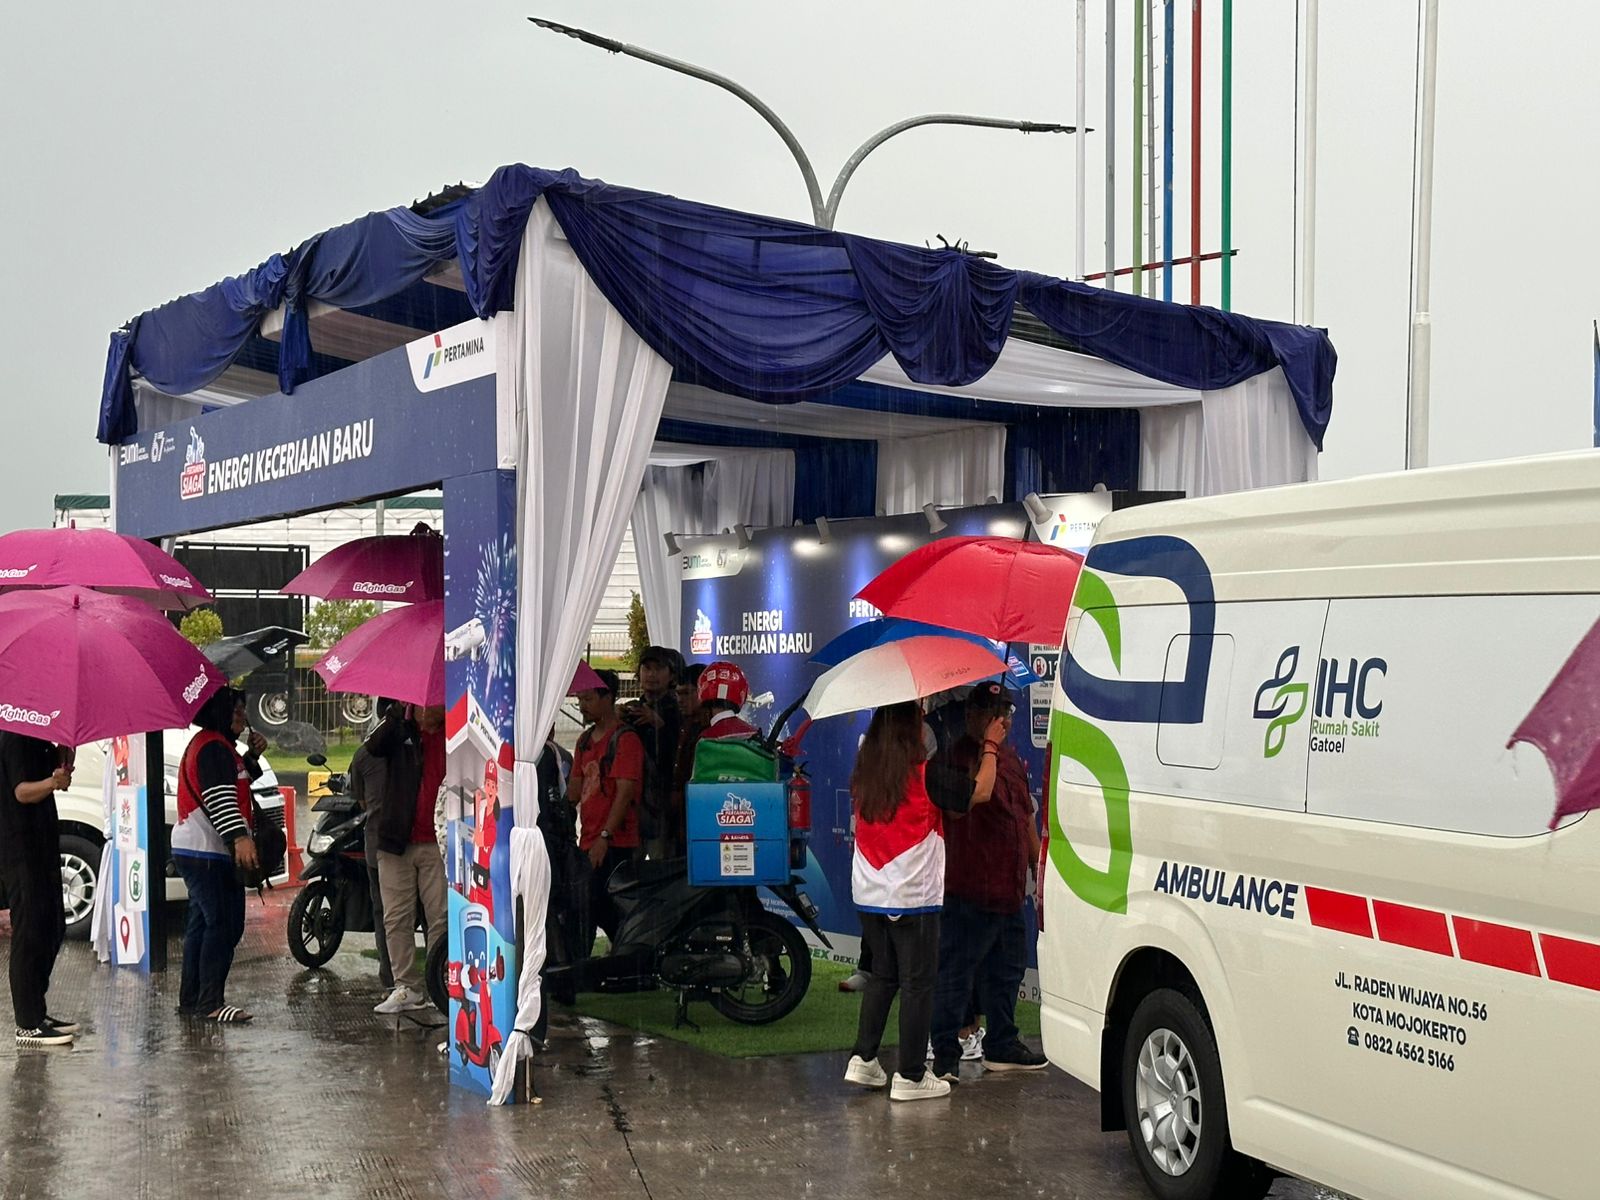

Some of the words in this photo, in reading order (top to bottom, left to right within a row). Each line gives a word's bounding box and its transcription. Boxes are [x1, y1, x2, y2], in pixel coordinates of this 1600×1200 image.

[444, 337, 484, 363] PERTAMINA
[207, 453, 254, 494] ENERGI
[254, 431, 331, 483] KECERIAAN
[332, 418, 373, 464] BARU
[182, 474, 203, 495] SIAGA
[353, 582, 386, 594] Bright
[385, 584, 406, 593] Gas
[742, 610, 782, 631] ENERGI
[716, 634, 777, 655] KECERIAAN
[780, 633, 812, 653] BARU
[1315, 658, 1387, 719] IHC
[0, 704, 27, 721] ight
[27, 711, 51, 726] Gas
[1311, 720, 1348, 735] Rumah
[1351, 721, 1380, 737] Sakit
[1310, 737, 1345, 753] Gatoel
[720, 815, 751, 824] SIAGA
[1153, 861, 1298, 919] AMBULANCE
[1335, 971, 1351, 990] JL.
[1354, 975, 1395, 999] RADEN
[1398, 985, 1445, 1011] WIJAYA
[1448, 996, 1487, 1021] NO.56
[1353, 1002, 1384, 1024] KOTA
[1386, 1010, 1466, 1045] MOJOKERTO
[1364, 1032, 1393, 1055] 0822
[1396, 1041, 1425, 1063] 4562
[1428, 1049, 1454, 1071] 5166
